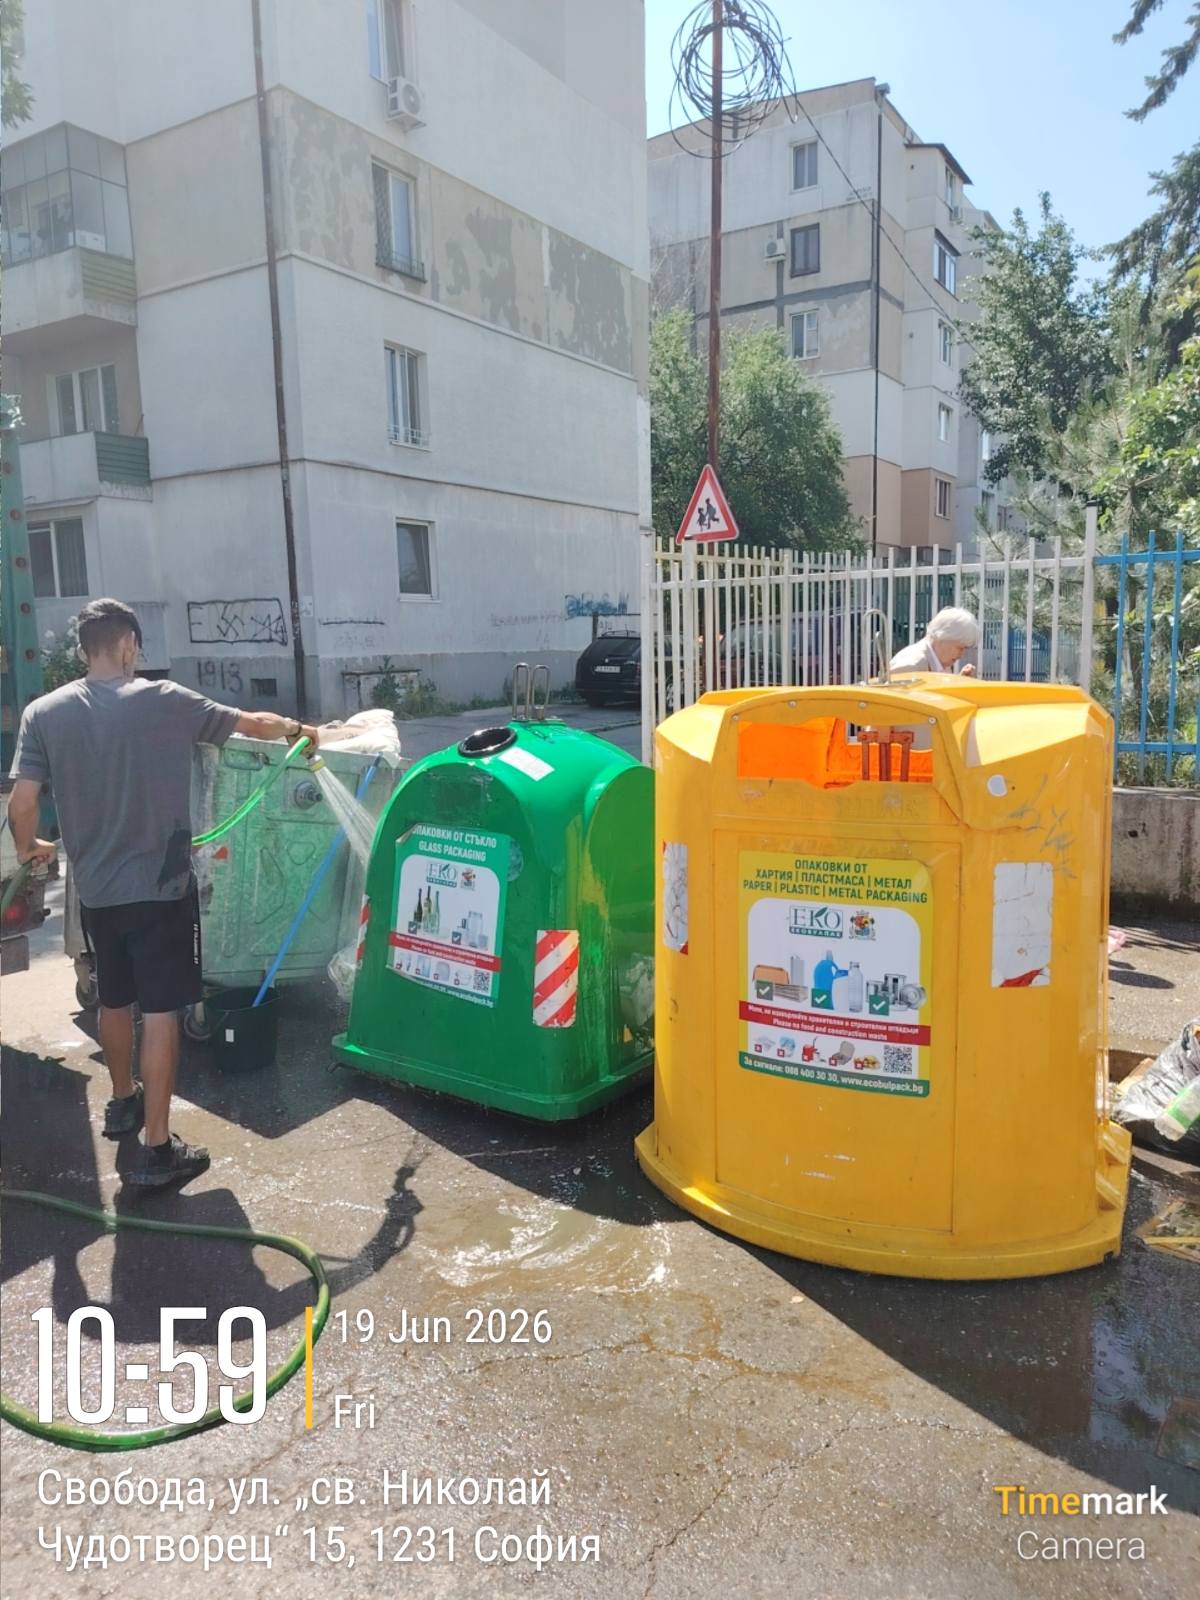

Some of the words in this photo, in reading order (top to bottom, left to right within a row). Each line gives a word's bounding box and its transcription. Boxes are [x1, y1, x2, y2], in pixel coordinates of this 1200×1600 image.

[453, 831, 464, 842] ОТ
[465, 833, 497, 848] СТЪКЛО
[419, 841, 442, 853] GLASS
[443, 845, 487, 862] PACKAGING
[795, 859, 851, 872] ОПАКОВКИ
[854, 863, 868, 873] ОТ
[756, 869, 793, 881] ХАРТИЯ
[801, 871, 864, 886] ПЛАСТМАСА
[874, 877, 912, 889] МЕТАЛ
[743, 880, 772, 890] PAPER
[780, 884, 820, 896] PLASTIC
[829, 888, 863, 899] METAL
[866, 890, 928, 903] PACKAGING
[743, 1056, 752, 1066] За
[800, 1068, 815, 1079] 400
[816, 1070, 826, 1081] 30
[841, 1076, 924, 1094] www.ecobulpack.bg
